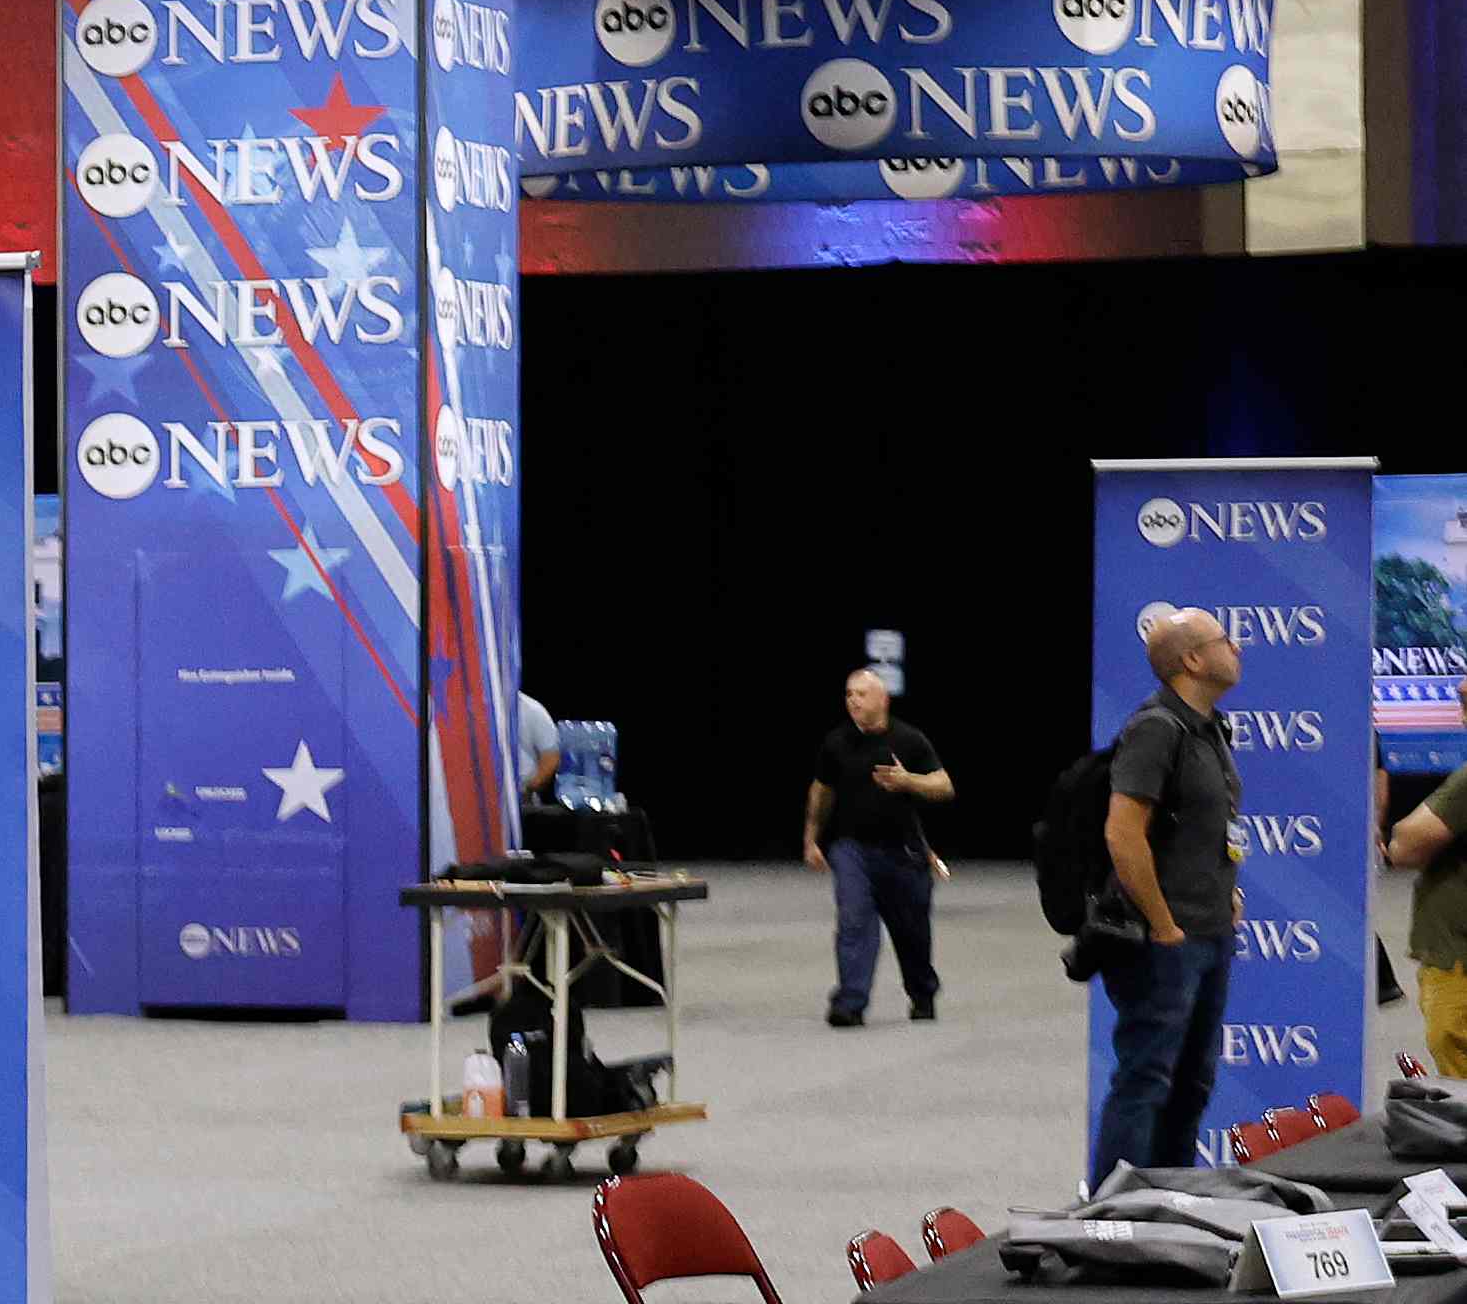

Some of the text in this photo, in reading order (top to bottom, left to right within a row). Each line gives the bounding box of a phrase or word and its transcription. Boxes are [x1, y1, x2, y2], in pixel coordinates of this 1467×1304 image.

[82, 15, 149, 46] abc
[453, 0, 512, 77] NEWS
[602, 3, 669, 35] abc
[513, 77, 704, 161] NEWS
[808, 65, 1156, 144] abc NEWS
[84, 133, 402, 207] abc NEWS
[455, 137, 513, 214] NEWS
[86, 275, 404, 349] abc NEWS
[456, 278, 514, 351] NEWS
[86, 415, 404, 489] abc NEWS
[1187, 501, 1328, 543] NEWS
[1223, 710, 1325, 751] EWS
[1227, 814, 1324, 857] EWS
[210, 926, 302, 959] NEWS
[1220, 1024, 1319, 1065] EWS
[1305, 1249, 1351, 1282] 769
